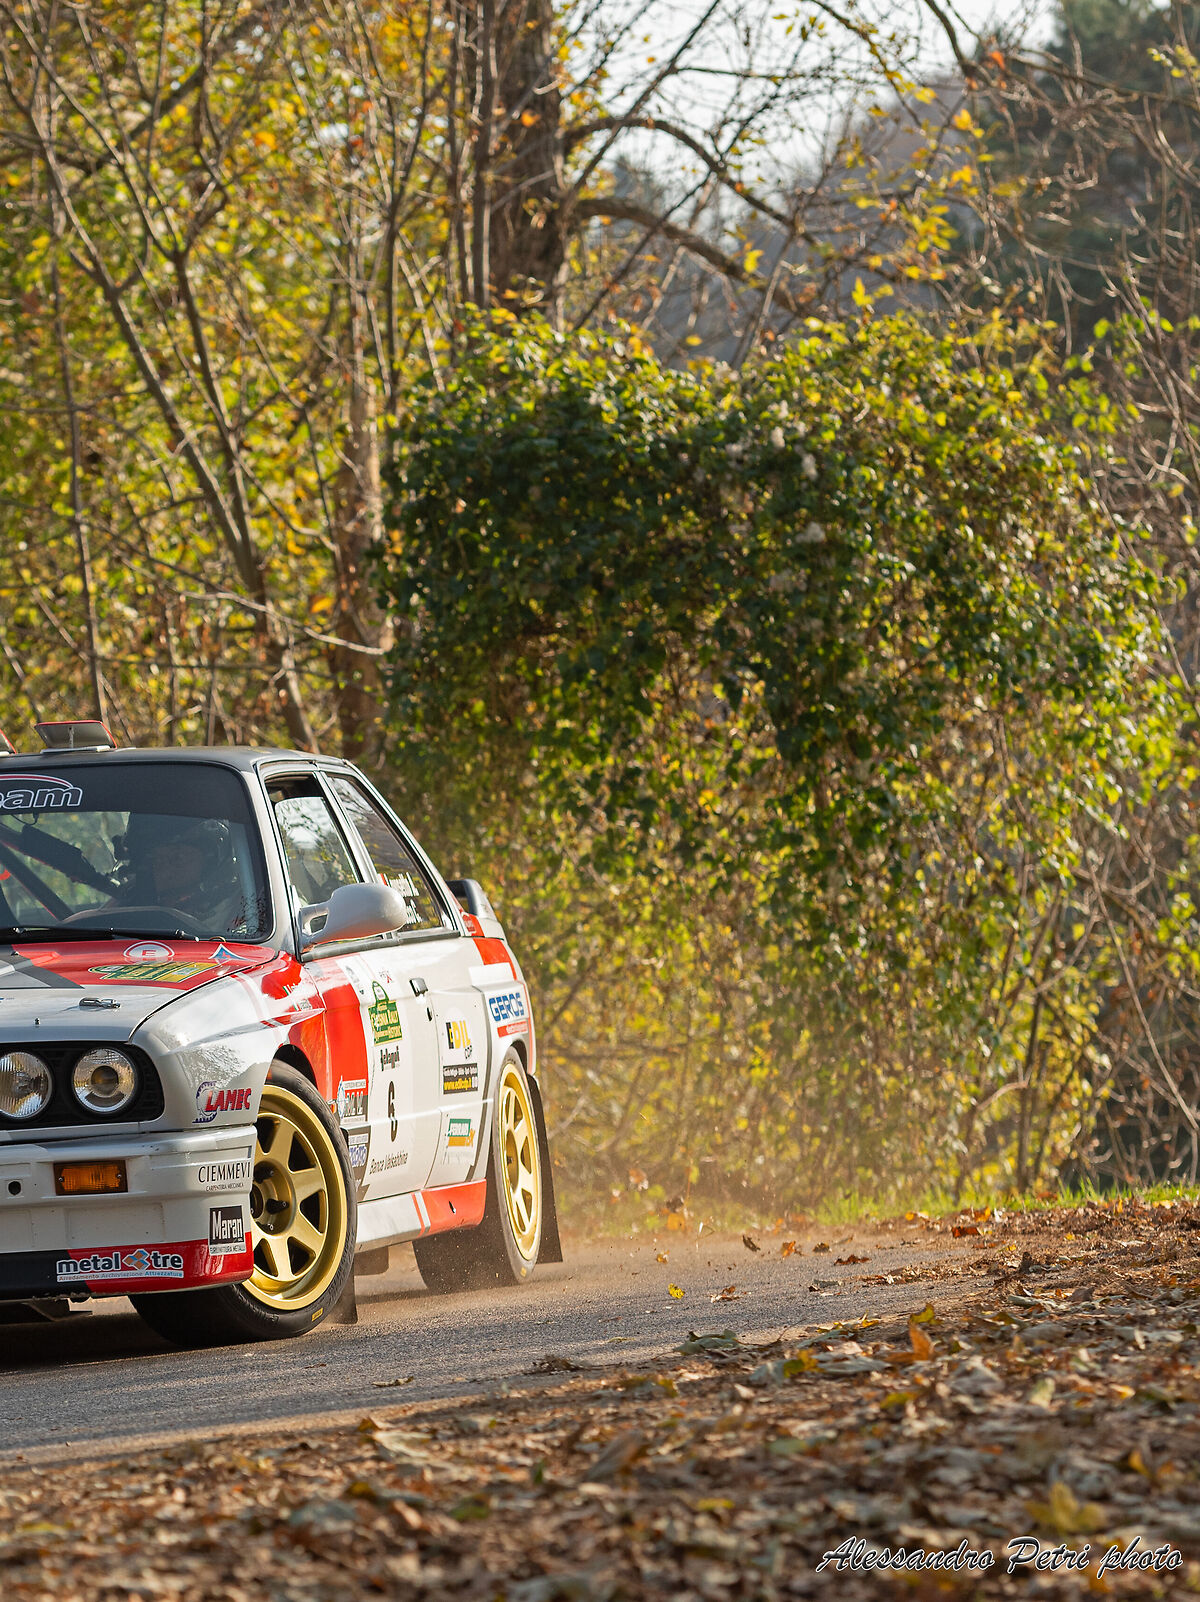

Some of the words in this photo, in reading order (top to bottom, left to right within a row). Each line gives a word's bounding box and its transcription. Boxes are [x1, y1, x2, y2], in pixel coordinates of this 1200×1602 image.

[488, 992, 525, 1022] GEROS
[445, 1020, 471, 1049] EDIL
[204, 1088, 252, 1113] LAMEC
[387, 1080, 398, 1142] 6
[198, 1161, 251, 1183] CIEMMEVI
[212, 1210, 243, 1240] Maran
[57, 1252, 120, 1274] metal
[150, 1251, 183, 1269] tre
